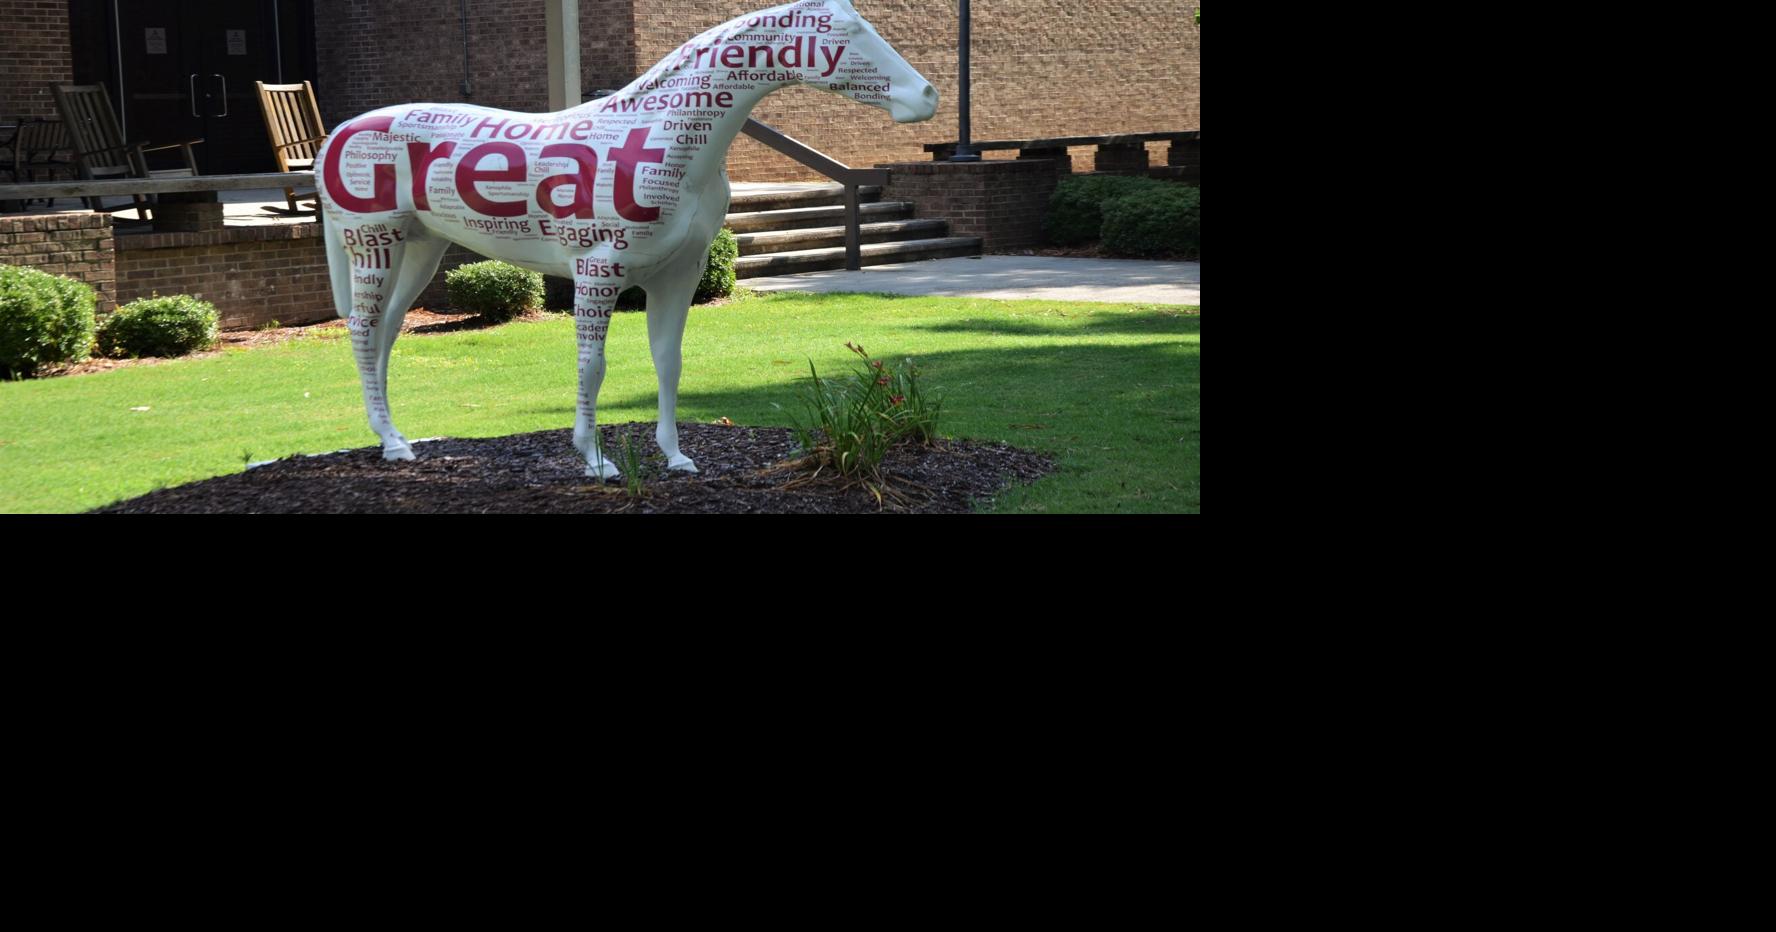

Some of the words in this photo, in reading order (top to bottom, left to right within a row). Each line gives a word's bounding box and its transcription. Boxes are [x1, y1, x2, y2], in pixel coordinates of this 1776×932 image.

[735, 10, 834, 33] onding
[727, 70, 803, 82] Affordable
[829, 82, 890, 92] Balanced
[600, 91, 734, 113] Awesome
[405, 109, 478, 128] Family
[667, 109, 726, 118] Philanthropy
[470, 117, 593, 140] Home
[664, 120, 712, 131] Driven
[372, 132, 421, 143] Majestic
[589, 133, 619, 141] Home
[676, 134, 708, 145] Chill
[345, 150, 397, 161] Philosophy
[324, 116, 665, 222] Great
[642, 166, 686, 180] Family
[643, 178, 680, 188] Focused
[429, 186, 455, 196] Family
[643, 193, 680, 202] Involved
[361, 224, 388, 233] Chill
[464, 216, 531, 233] Inspiring
[344, 228, 404, 247] Blast
[539, 220, 628, 250] Egaging
[344, 246, 391, 269] hill
[590, 256, 607, 264] Great
[576, 258, 624, 278] Blast
